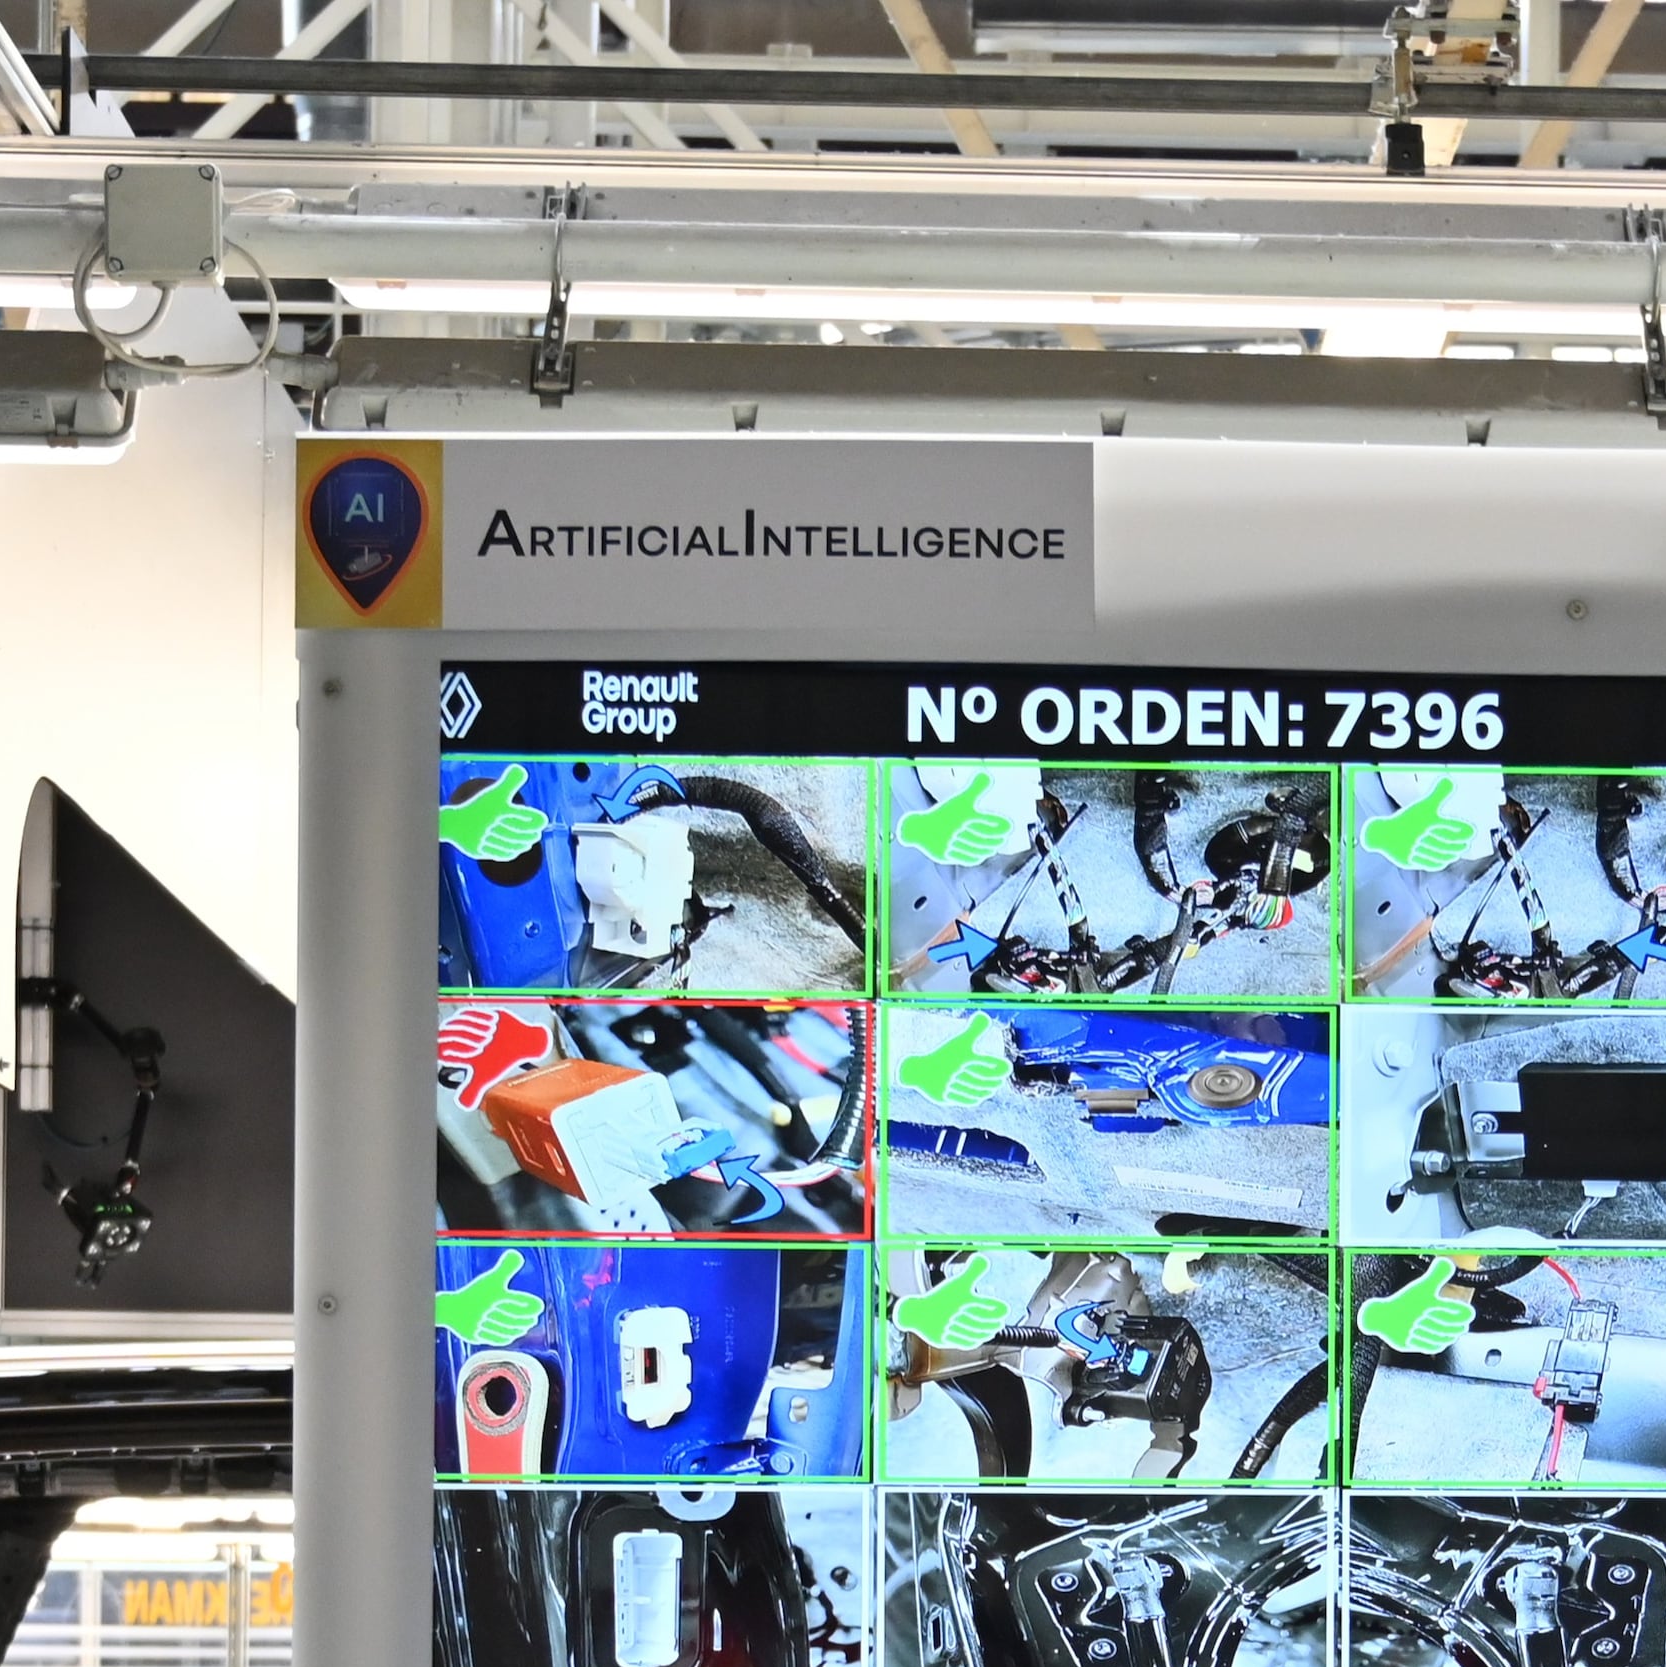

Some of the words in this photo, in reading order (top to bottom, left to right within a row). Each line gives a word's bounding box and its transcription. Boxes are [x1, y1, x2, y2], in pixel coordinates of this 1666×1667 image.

[344, 494, 384, 522] AI
[582, 670, 699, 704] Renault
[581, 702, 677, 743] Group
[1020, 687, 1304, 747] ORDEN:
[1324, 692, 1505, 751] 7396
